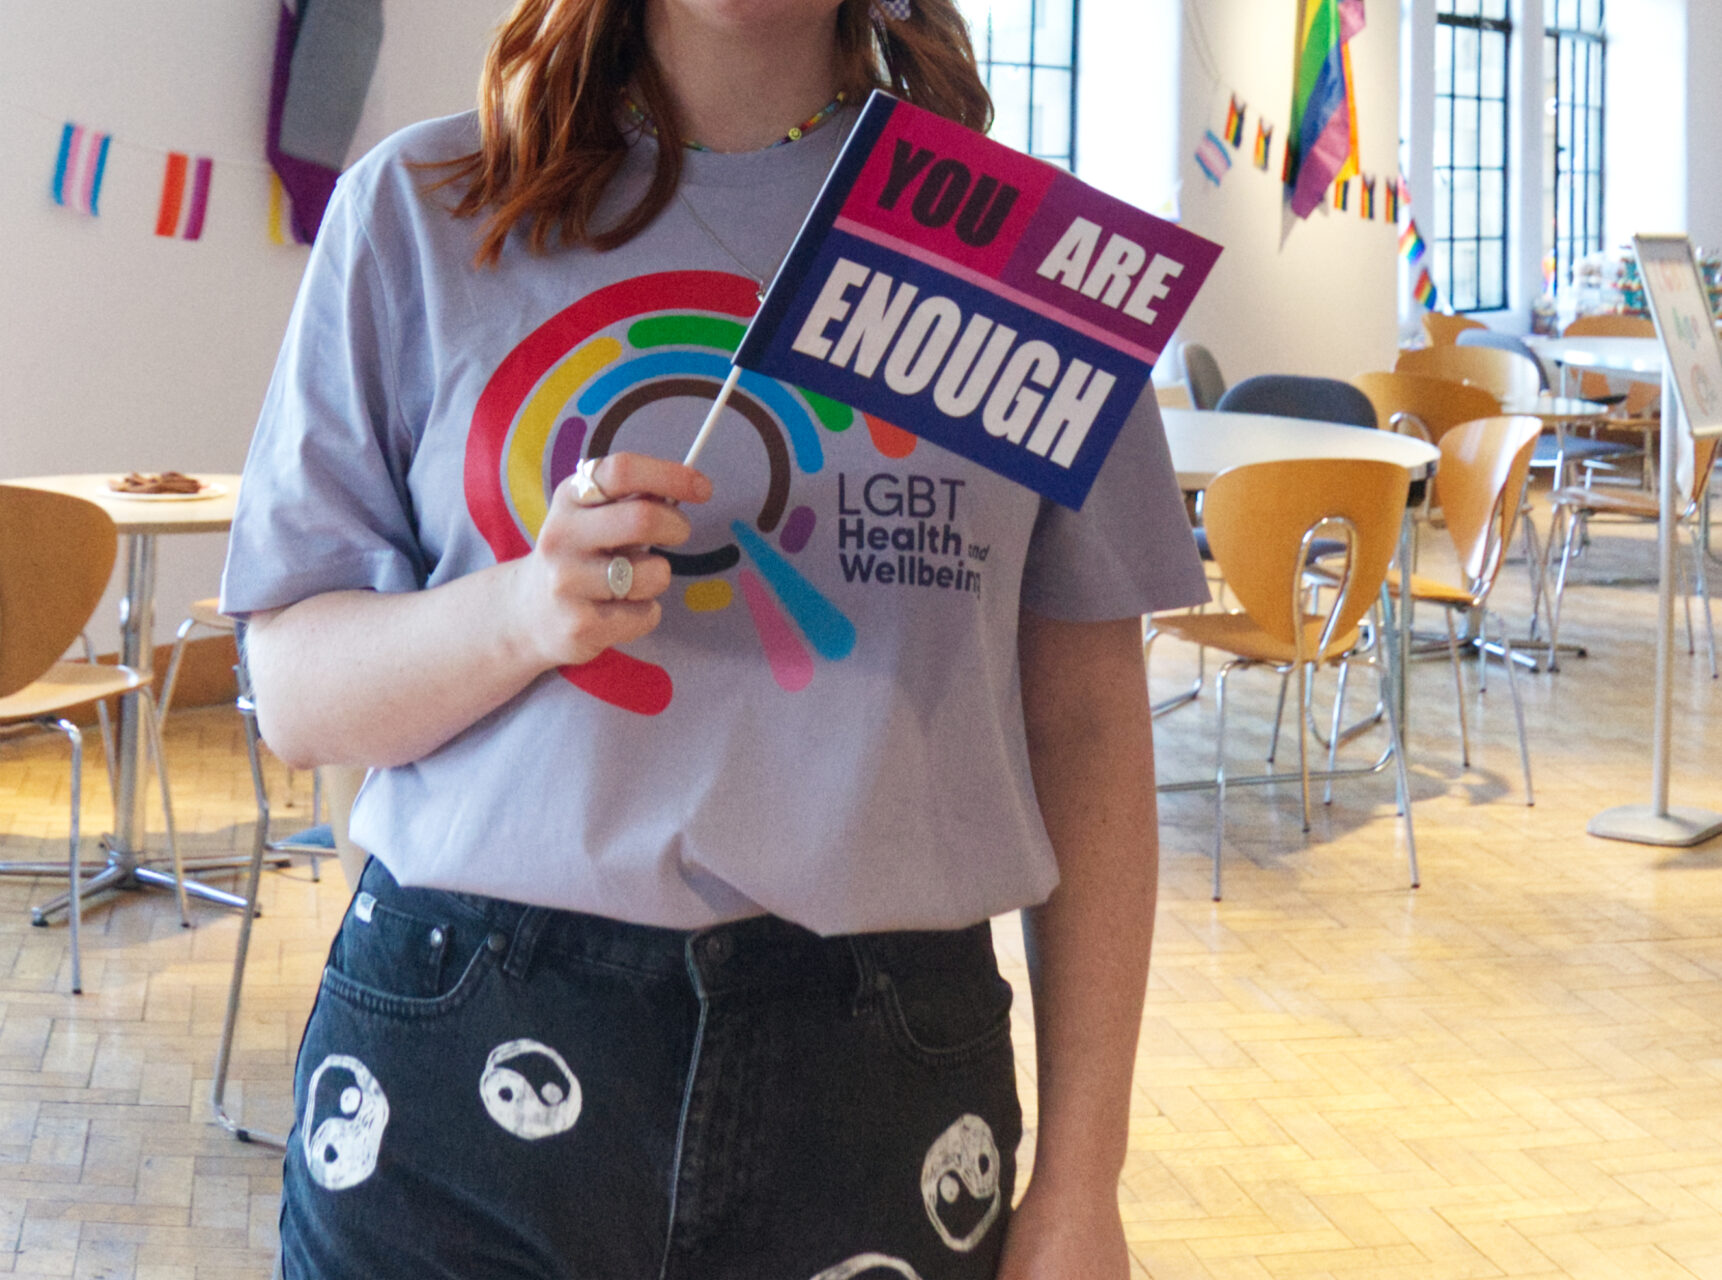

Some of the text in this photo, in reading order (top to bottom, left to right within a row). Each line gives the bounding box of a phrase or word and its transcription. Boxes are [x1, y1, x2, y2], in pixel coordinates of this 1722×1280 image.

[876, 138, 1185, 325] YOU ARE
[791, 257, 1117, 469] ENOUGH
[838, 518, 962, 557] Health
[839, 472, 966, 522] LGBT
